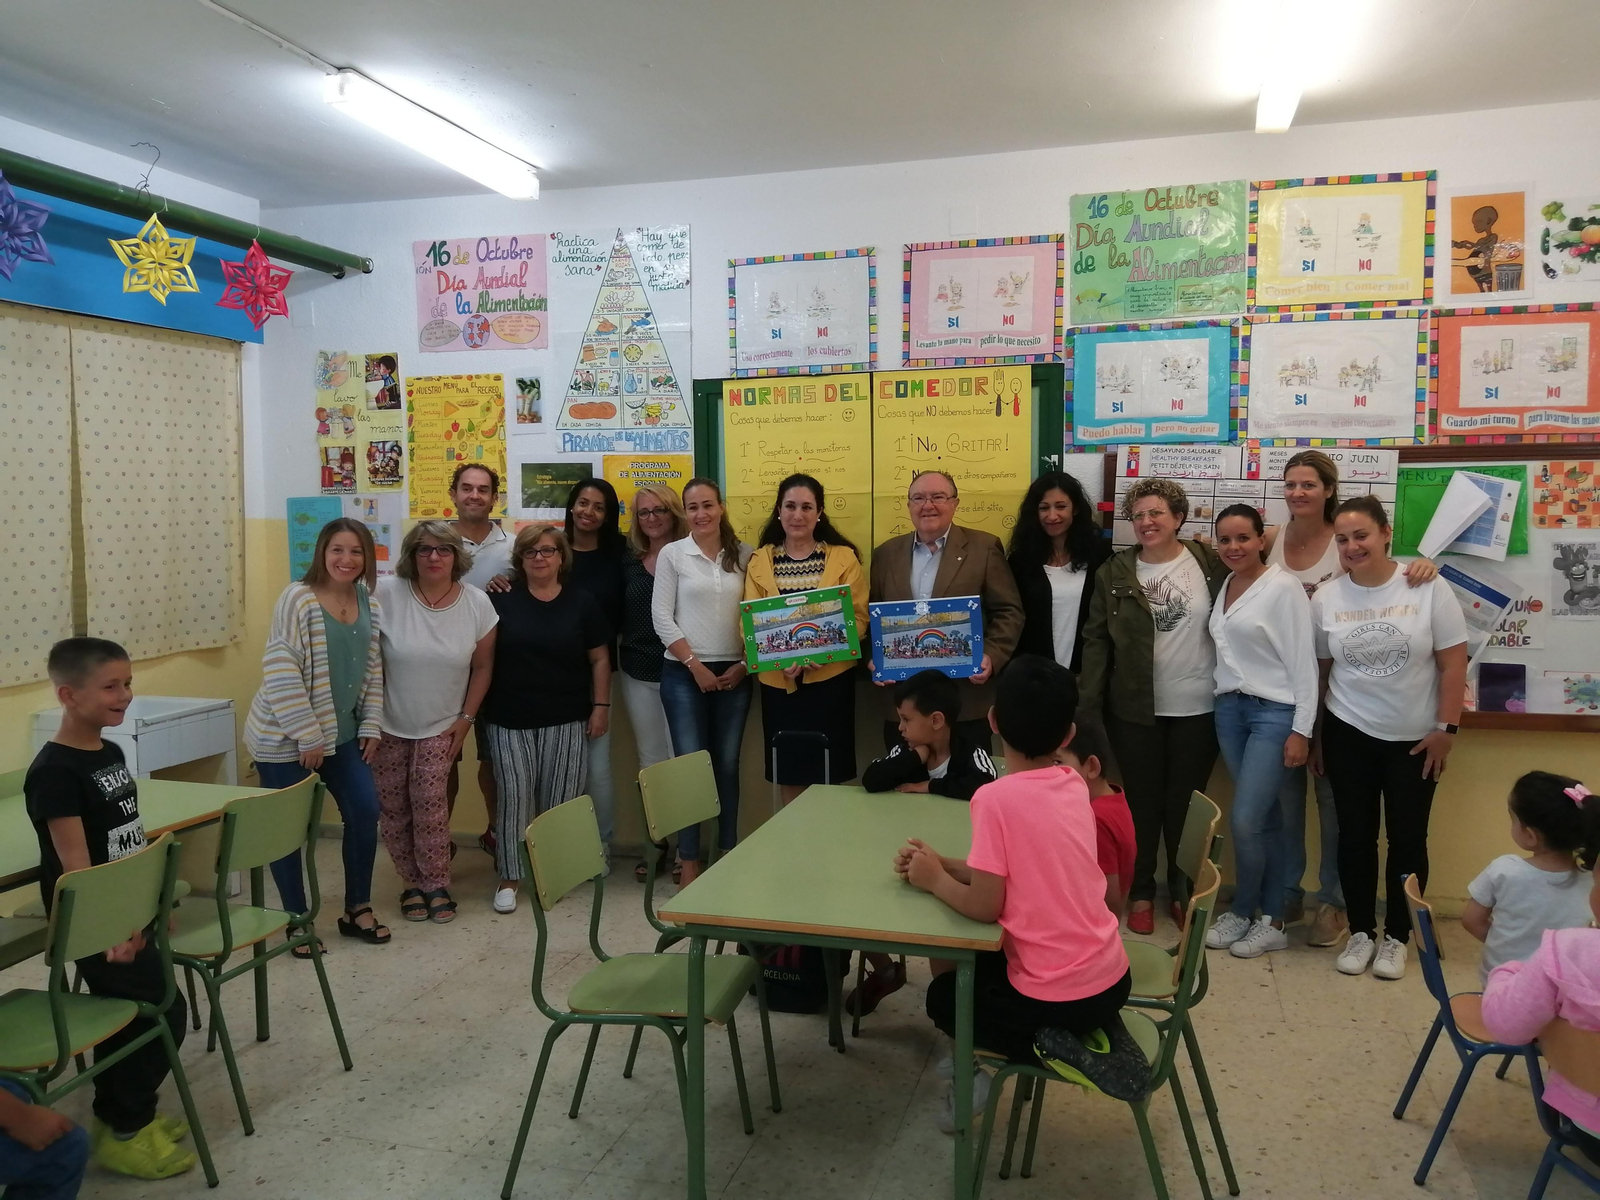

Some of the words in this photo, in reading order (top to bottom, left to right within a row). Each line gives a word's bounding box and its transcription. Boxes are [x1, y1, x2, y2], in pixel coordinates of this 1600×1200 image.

[1087, 194, 1109, 219] 16
[1115, 192, 1134, 218] de
[1144, 184, 1219, 212] Octubre
[1075, 222, 1116, 251] Día
[1123, 208, 1210, 243] Mundial
[668, 231, 687, 244] que
[426, 240, 451, 267] 16
[453, 245, 470, 266] de
[476, 237, 534, 262] Octubre
[568, 247, 593, 255] una
[637, 242, 667, 252] comer
[672, 240, 686, 249] de
[551, 250, 608, 264] alimentación
[1073, 251, 1096, 275] de
[1108, 243, 1131, 269] la
[1126, 245, 1246, 282] Alimentación
[1359, 258, 1372, 273] NO
[437, 270, 468, 295] Día
[472, 261, 528, 290] Mundial
[1265, 284, 1302, 297] Comer
[1305, 280, 1331, 292] bien
[1344, 281, 1386, 292] Comer
[431, 297, 448, 319] de
[456, 292, 473, 315] la
[1002, 314, 1014, 326] NO
[817, 326, 829, 339] NO
[915, 339, 937, 348] Levanto
[943, 338, 958, 346] mano
[959, 337, 972, 347] para
[980, 334, 996, 347] pedir
[997, 333, 1003, 343] lo
[1004, 336, 1016, 346] que
[1017, 335, 1041, 346] necesito
[753, 349, 793, 361] correctamente
[807, 347, 817, 356] los
[819, 346, 852, 357] cubiertos
[347, 360, 362, 379] Me
[415, 386, 442, 396] NUESTRO
[443, 381, 459, 392] MENÚ
[456, 387, 469, 395] PARA
[477, 386, 499, 395] RECREO
[729, 384, 817, 406] NORMAS
[824, 382, 868, 403] DEL
[879, 376, 989, 399] COMEDOR
[1546, 384, 1561, 399] NO
[333, 388, 359, 402] lavo
[1354, 394, 1367, 407] NO
[418, 400, 439, 408] Lunes
[1171, 398, 1184, 411] NO
[356, 409, 371, 421] las
[730, 411, 754, 426] Cosas
[755, 415, 770, 430] que
[772, 412, 803, 424] debemos
[878, 404, 907, 419] Cosas
[909, 410, 925, 425] que
[926, 405, 937, 416] NO
[938, 406, 972, 417] debemos
[1446, 415, 1477, 426] Guardo
[1479, 414, 1491, 425] mi
[1492, 414, 1516, 425] turno
[1528, 414, 1543, 425] para
[1544, 411, 1570, 424] lavarme
[1571, 413, 1580, 424] las
[1581, 416, 1600, 425] mano
[370, 427, 403, 438] manos
[413, 431, 442, 441] Tuesday
[1082, 427, 1110, 438] Puedo
[1112, 423, 1143, 436] hablar
[1154, 424, 1175, 434] pero
[1176, 424, 1188, 432] no
[1189, 424, 1216, 435] gritar
[758, 440, 793, 458] Respetar
[803, 441, 814, 454] las
[816, 440, 851, 455] monitoras
[1186, 447, 1222, 455] SALUDABLE
[1350, 453, 1379, 464] JUIN
[629, 462, 670, 470] PROGRAMA
[758, 467, 790, 477] Levantar
[618, 471, 628, 479] DE
[963, 468, 980, 480] otros
[980, 470, 1017, 482] compañeros
[1396, 469, 1437, 482] MENU
[761, 479, 776, 487] hace
[1555, 483, 1568, 492] Tu
[971, 500, 985, 512] del
[987, 501, 1004, 512] sitio
[1334, 608, 1376, 623] WONDER
[1351, 624, 1376, 638] GIRLS
[1378, 623, 1397, 635] CAN
[1345, 653, 1361, 668] TOO
[1398, 650, 1407, 661] BE
[1364, 661, 1401, 675] HEROES
[118, 796, 137, 816] THE
[763, 969, 801, 981] RCELONA
